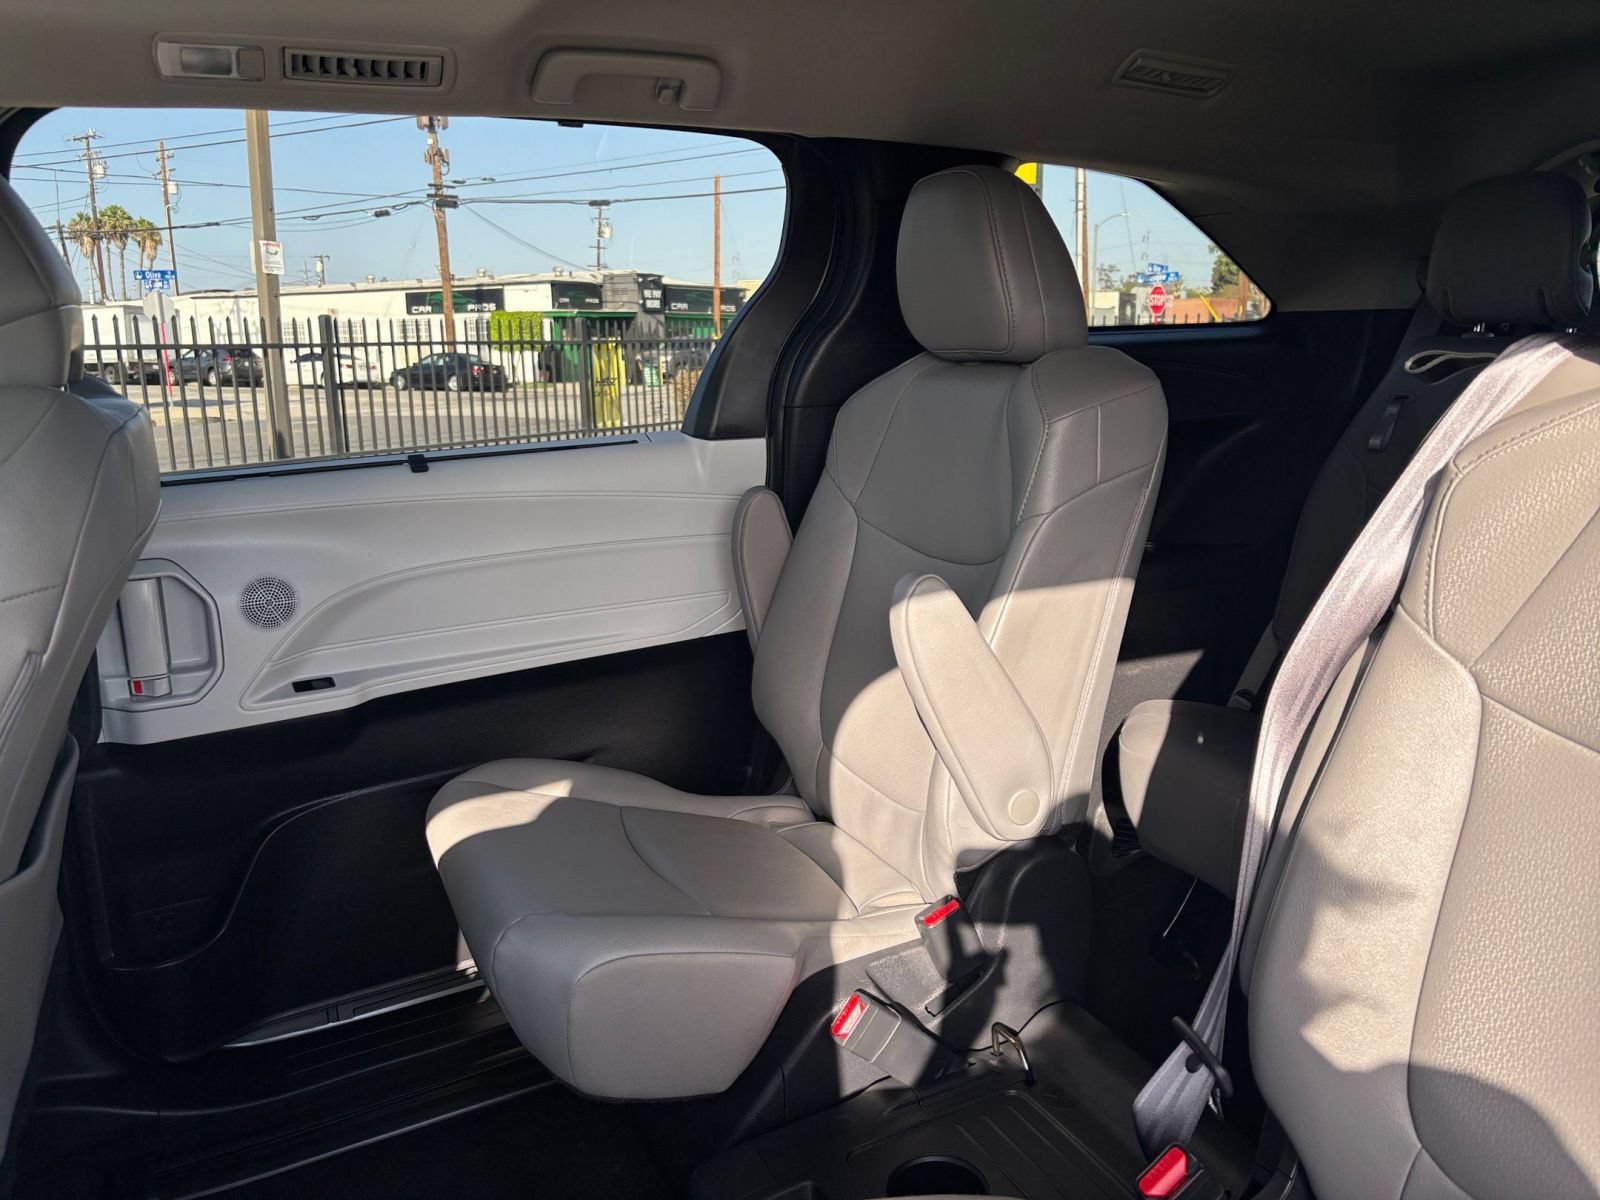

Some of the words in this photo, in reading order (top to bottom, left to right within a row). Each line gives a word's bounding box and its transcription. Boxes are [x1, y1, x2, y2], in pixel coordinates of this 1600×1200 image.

[145, 271, 161, 279] Olive
[1149, 294, 1166, 306] STOP
[411, 305, 433, 314] CAR
[467, 303, 496, 312] PROS
[671, 303, 689, 311] CAR
